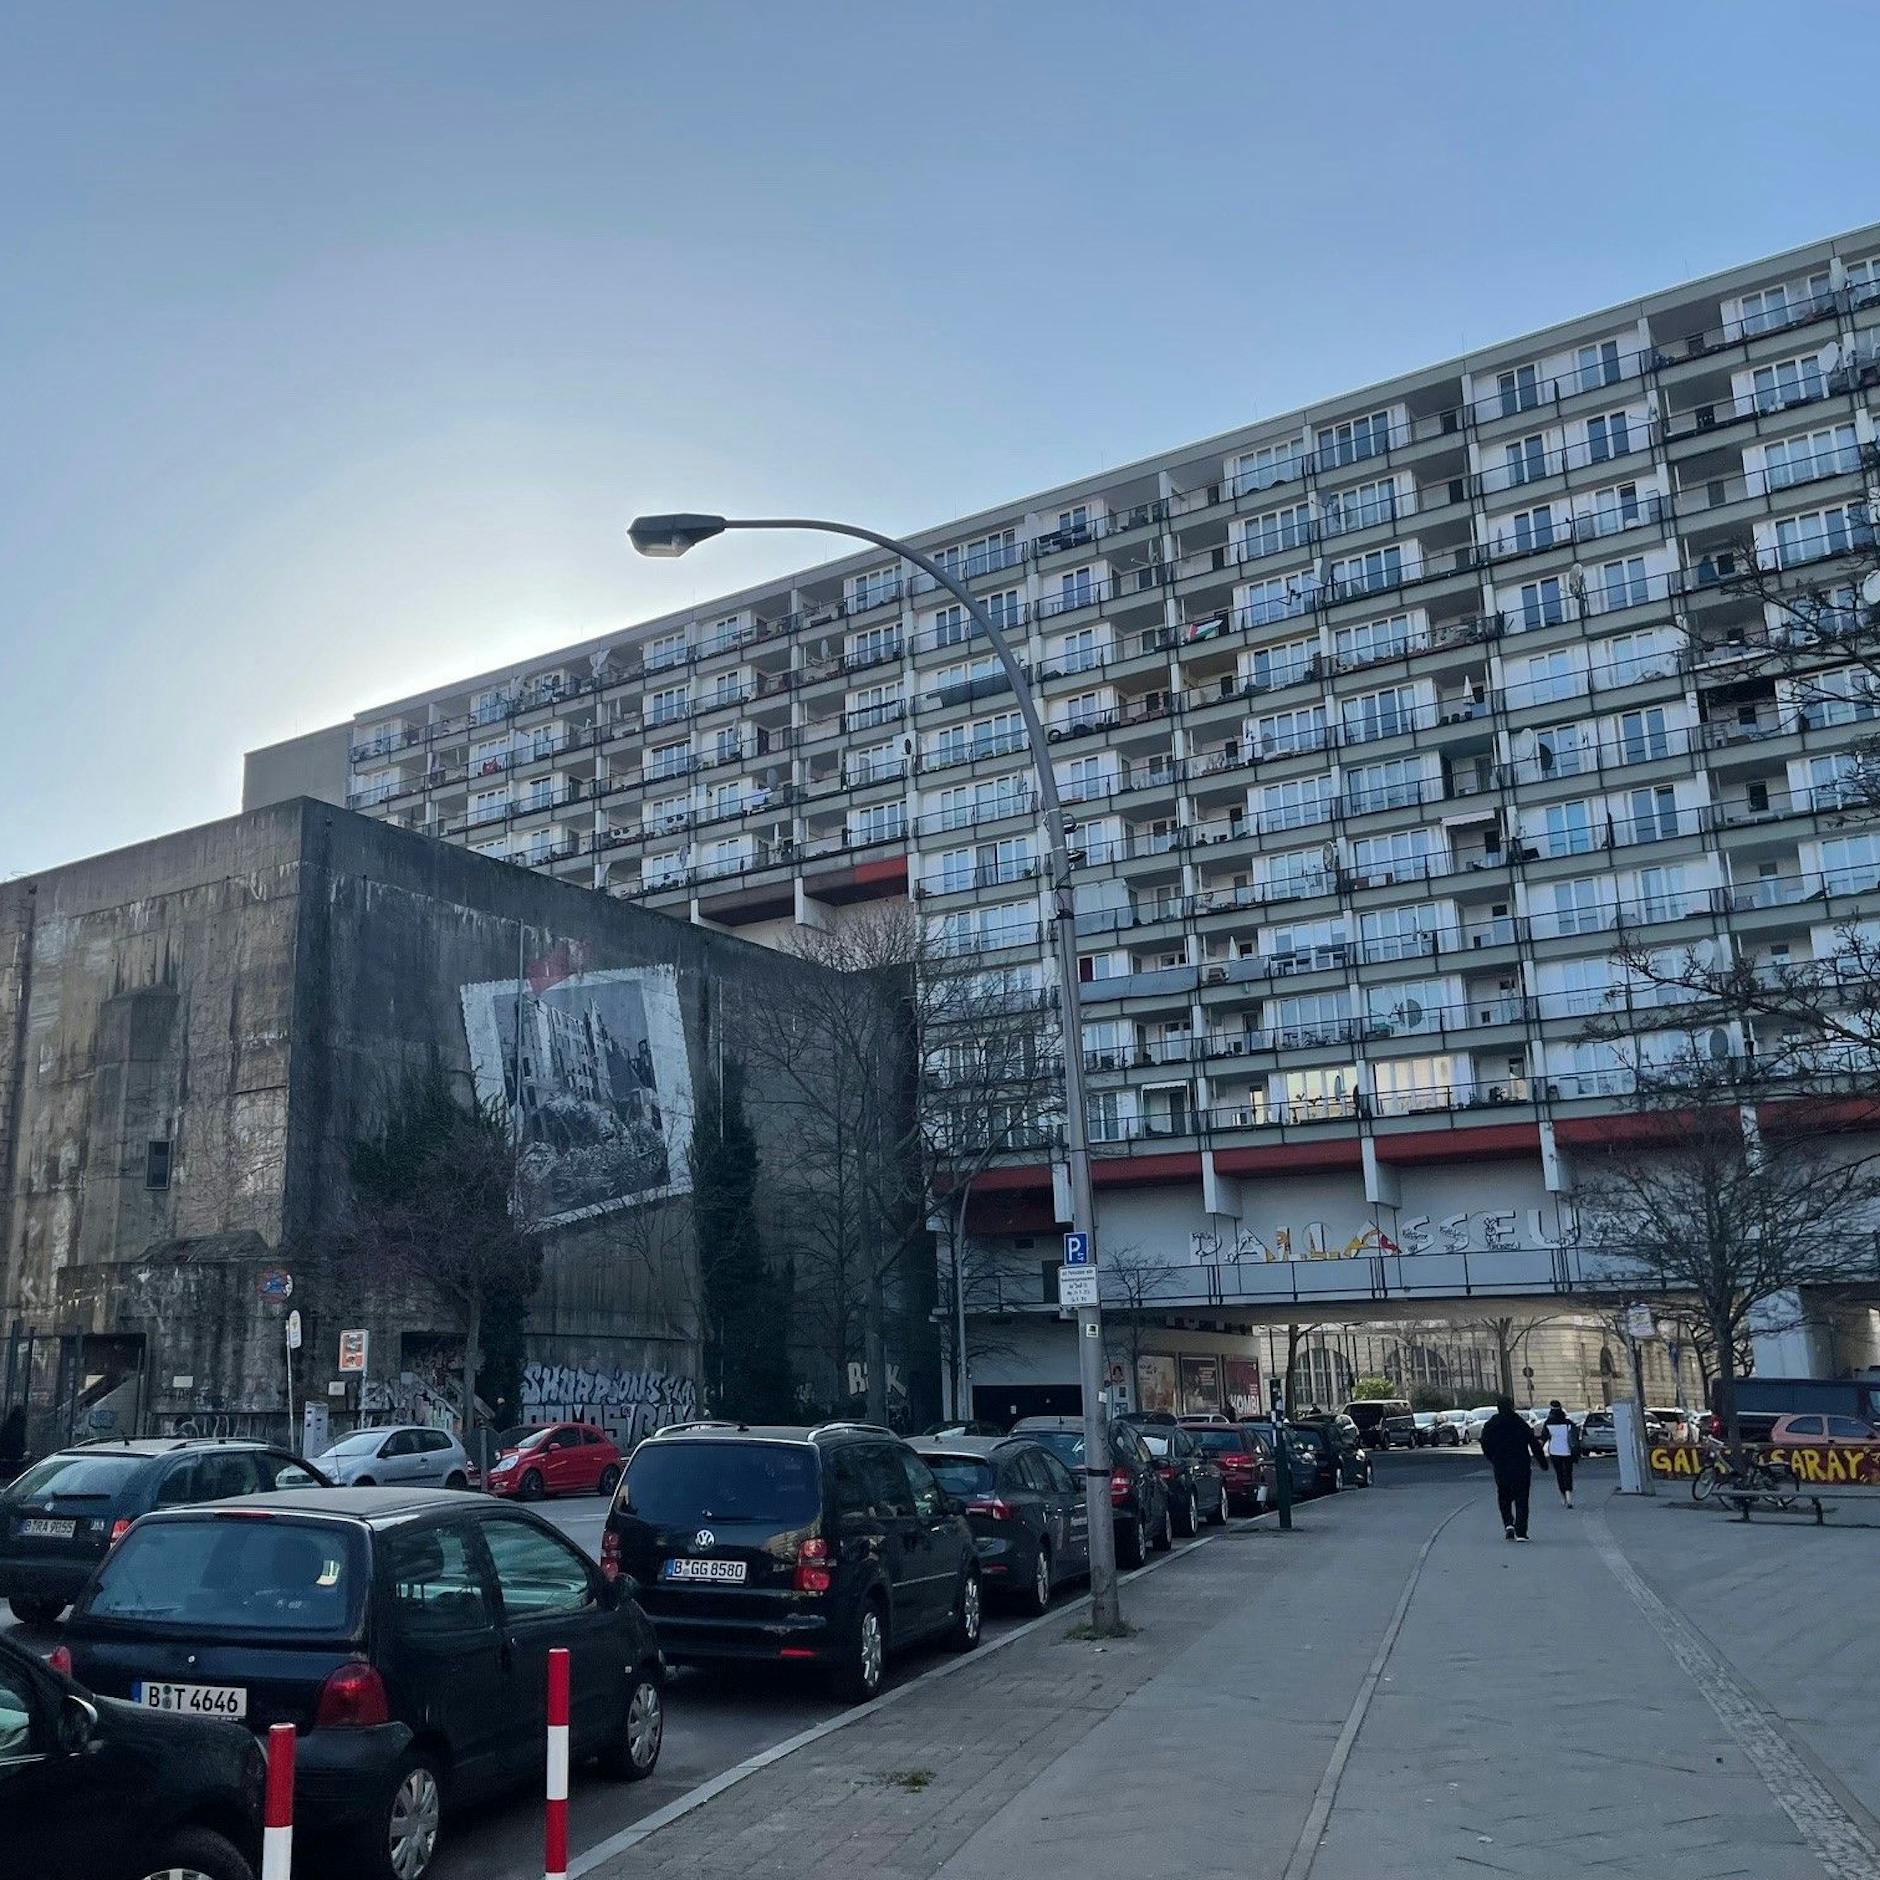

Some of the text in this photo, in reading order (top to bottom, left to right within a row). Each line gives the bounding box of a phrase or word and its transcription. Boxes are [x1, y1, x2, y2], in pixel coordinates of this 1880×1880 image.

[674, 1560, 744, 1578] B GG 8580
[149, 1686, 238, 1713] B T 4646
